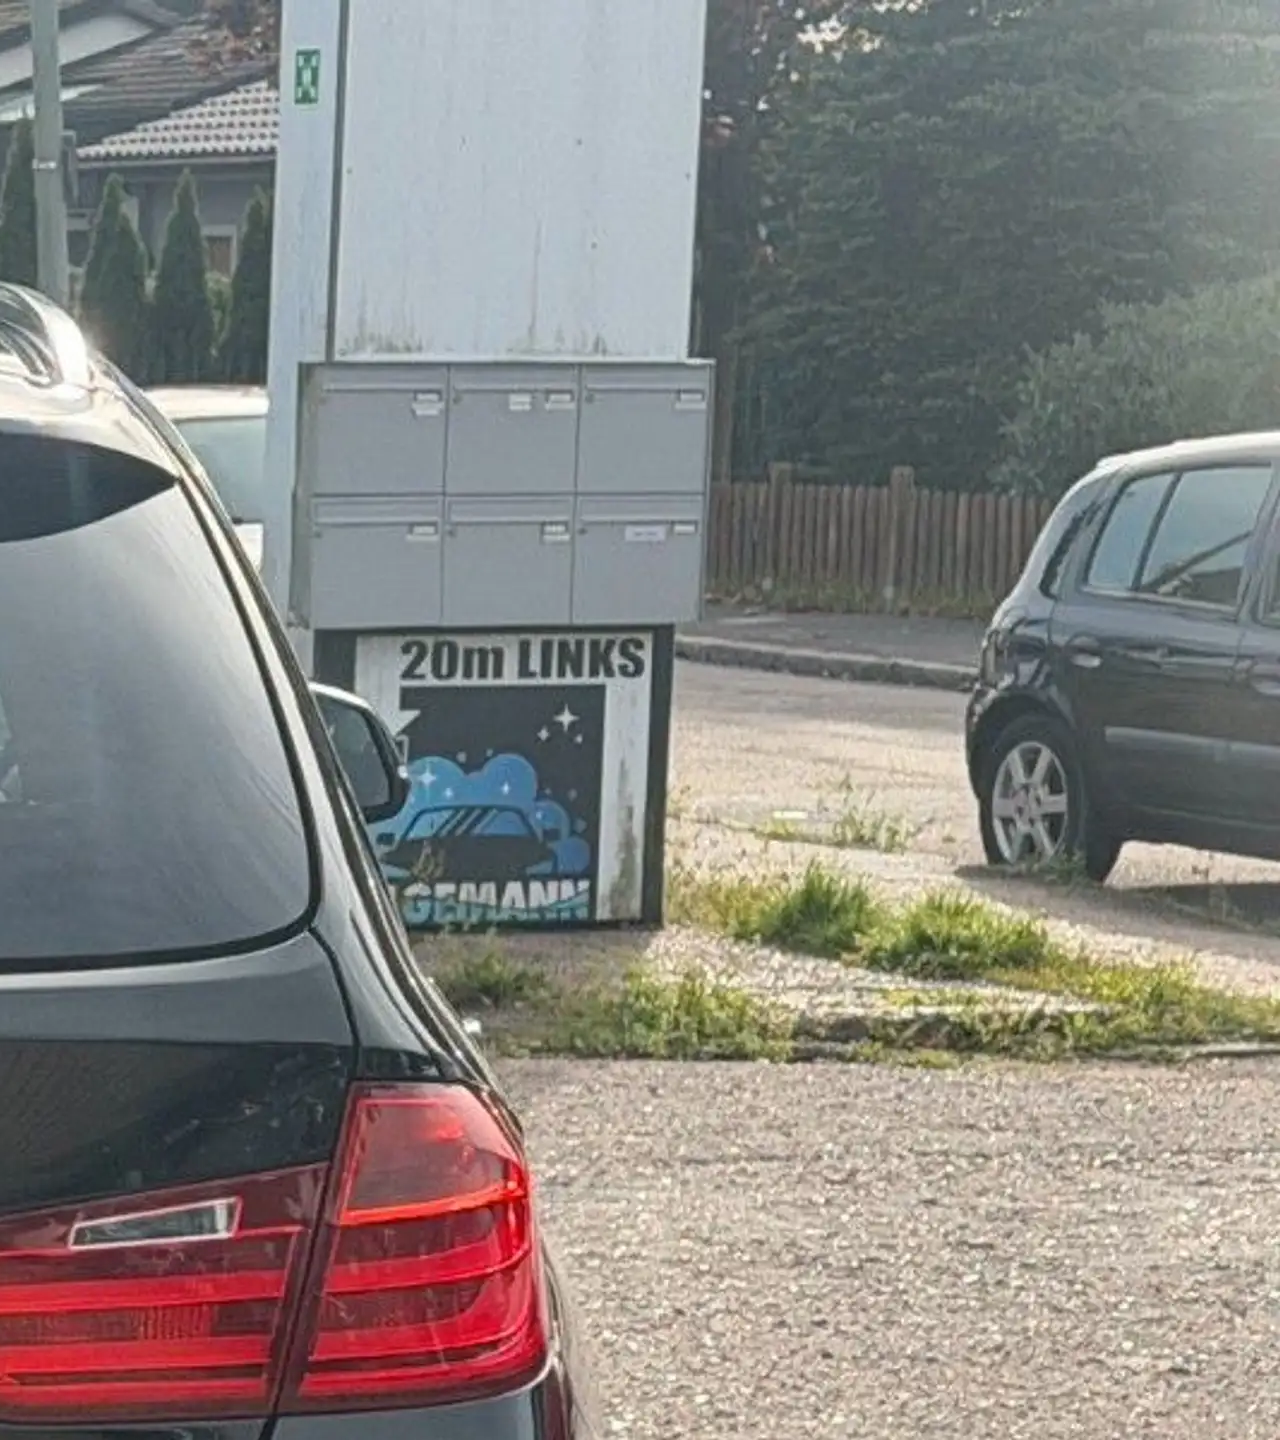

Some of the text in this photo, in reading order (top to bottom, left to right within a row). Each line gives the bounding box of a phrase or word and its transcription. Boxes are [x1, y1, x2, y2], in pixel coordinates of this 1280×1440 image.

[399, 638, 646, 681] 20m LINKS
[389, 880, 591, 924] GEMANN
